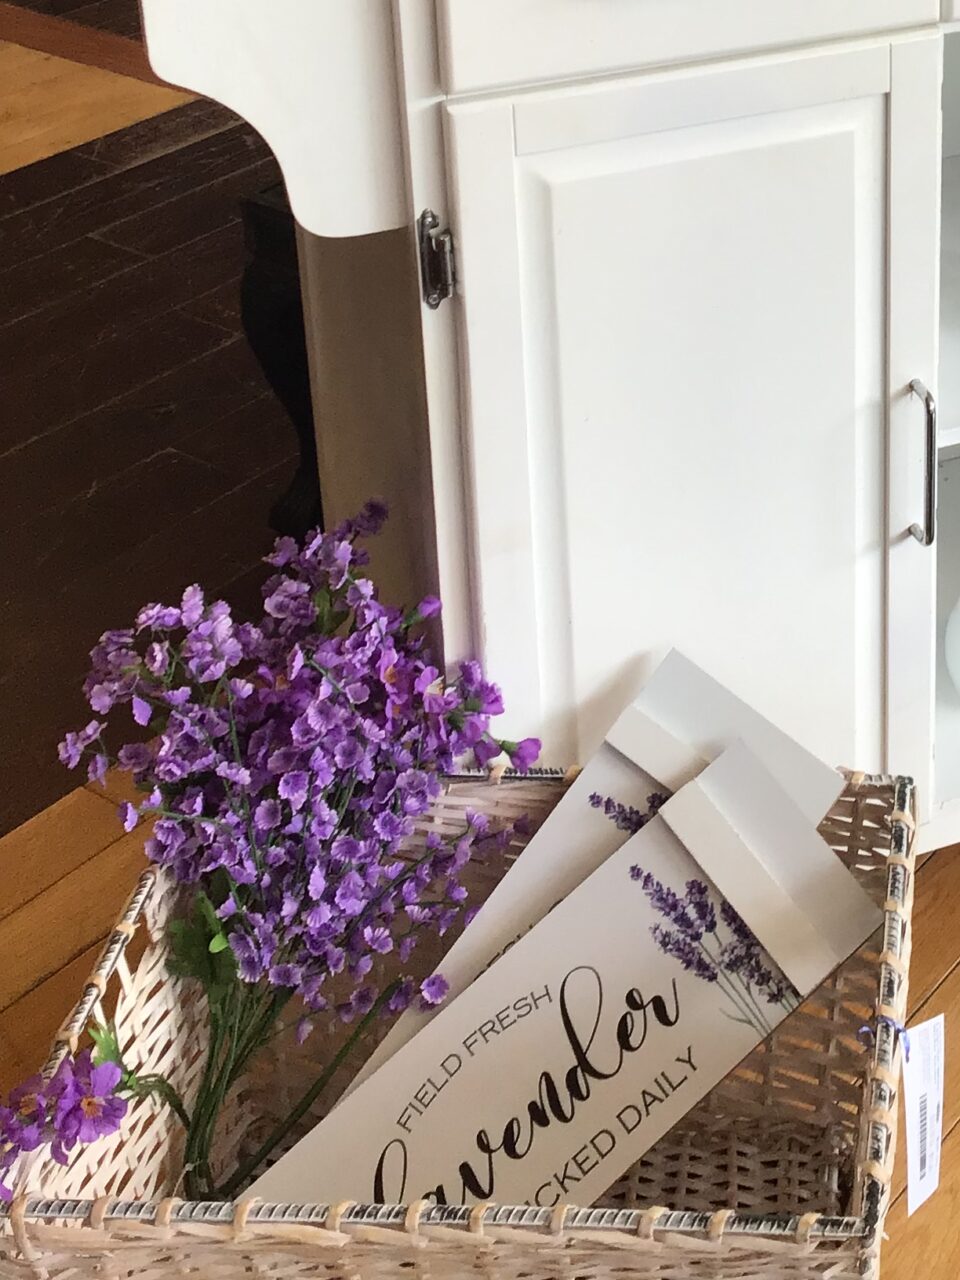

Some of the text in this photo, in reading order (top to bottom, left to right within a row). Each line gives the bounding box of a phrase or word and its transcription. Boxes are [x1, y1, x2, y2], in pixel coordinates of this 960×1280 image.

[396, 984, 554, 1134] FIELD FRESH
[525, 1045, 699, 1208] CKED DAILY
